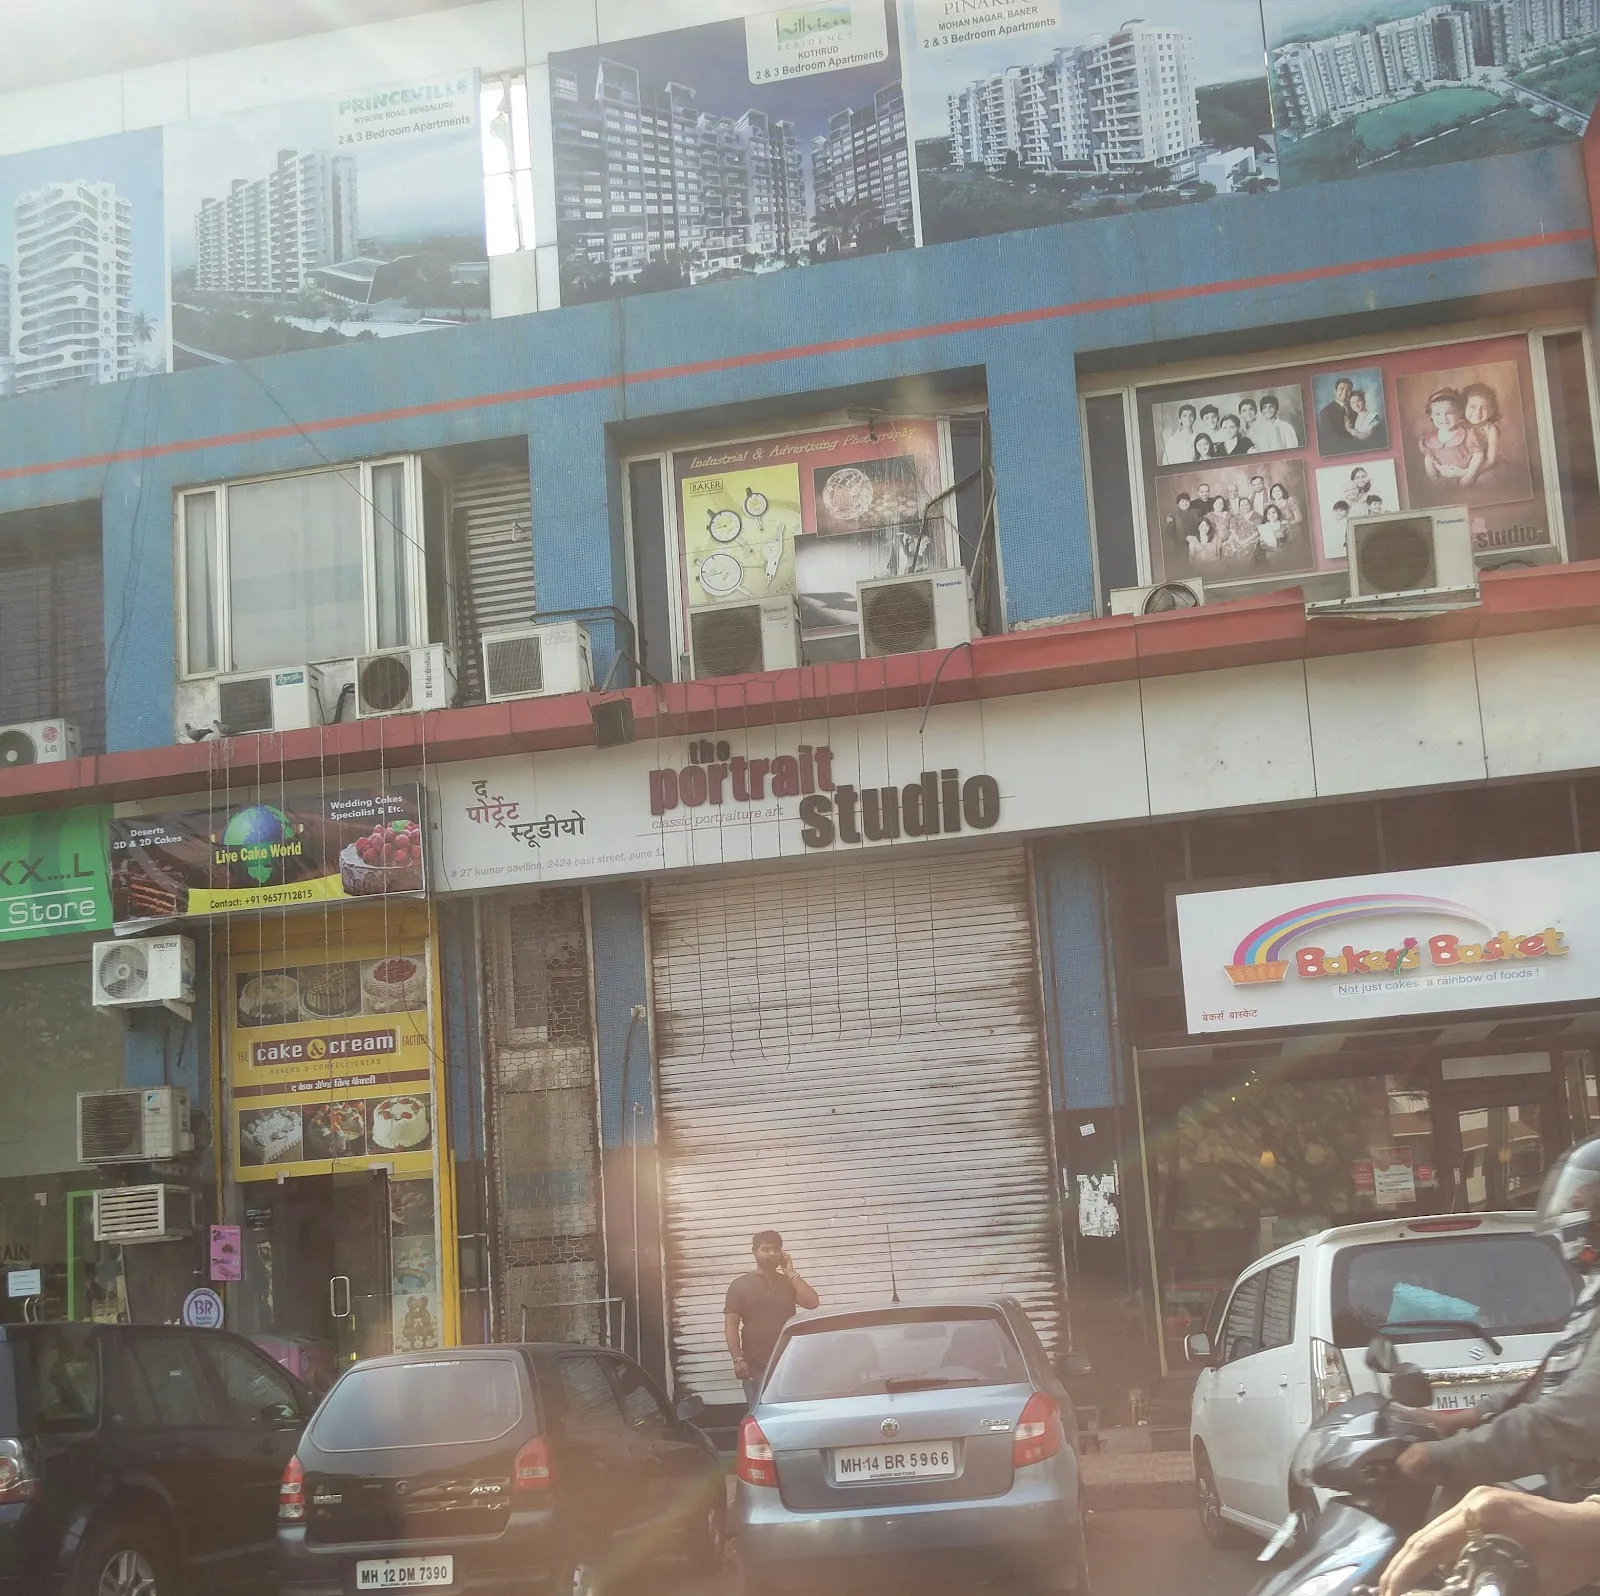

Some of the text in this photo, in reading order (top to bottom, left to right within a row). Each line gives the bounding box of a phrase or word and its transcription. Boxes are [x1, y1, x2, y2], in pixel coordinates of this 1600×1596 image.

[938, 6, 1038, 31] MOHAN NAGAR, BANER
[777, 32, 853, 52] RESIDENCY
[923, 17, 1056, 48] 2 & 3 Bedroom Apartments
[797, 45, 839, 60] KOTHRUD
[756, 49, 884, 80] 2 & 3 Bedroom Apartments
[338, 78, 468, 115] PRINCEVILLE
[353, 112, 384, 124] MYSORE
[409, 101, 454, 115] BENGALURU
[338, 115, 471, 145] 2 & 3 Bedroom Apartments
[689, 451, 749, 469] Industrial
[752, 447, 764, 460] &
[769, 440, 838, 457] Advertising
[692, 480, 721, 492] BAKER
[1477, 524, 1537, 548] studio
[45, 745, 57, 753] LG
[688, 739, 730, 764] the
[472, 780, 488, 798] द
[649, 745, 834, 816] portrait
[330, 796, 403, 809] Wedding Cakes
[330, 805, 404, 821] Specialist & Etc.
[799, 768, 1000, 848] studio
[651, 804, 784, 829] classic portraiture art
[130, 827, 165, 837] Deserts
[509, 809, 586, 848] स्टूडीयो
[114, 836, 182, 849] 3D & 2D Cakes
[215, 841, 302, 864] Live Cake World
[451, 870, 458, 878] #
[460, 868, 473, 878] 27
[475, 865, 504, 876] kumar
[547, 858, 572, 869] 2424
[574, 856, 595, 866] east
[597, 853, 627, 864] street,
[629, 851, 653, 862] pune
[9, 899, 96, 925] Store
[210, 898, 242, 909] Contact:
[244, 895, 260, 905] +91
[1428, 927, 1570, 966] Basket
[1338, 984, 1359, 994] Not
[1361, 983, 1382, 994] just
[1385, 978, 1422, 990] cakes,
[1426, 979, 1433, 987] a
[1437, 974, 1482, 985] rainbow
[1485, 970, 1497, 981] of
[1499, 967, 1532, 979] foods
[237, 1051, 249, 1062] THE
[257, 1042, 303, 1061] cake
[310, 1040, 324, 1057] &
[329, 1035, 394, 1053] cream
[269, 1066, 300, 1075] BAKERS
[313, 1058, 381, 1071] CONFECTIONERS
[194, 1300, 213, 1315] BR
[1436, 1395, 1458, 1409] MH
[1462, 1394, 1475, 1407] 14
[885, 1454, 905, 1469] BR
[910, 1451, 949, 1467] 5966
[361, 1566, 447, 1583] MH 12 DM 7390
